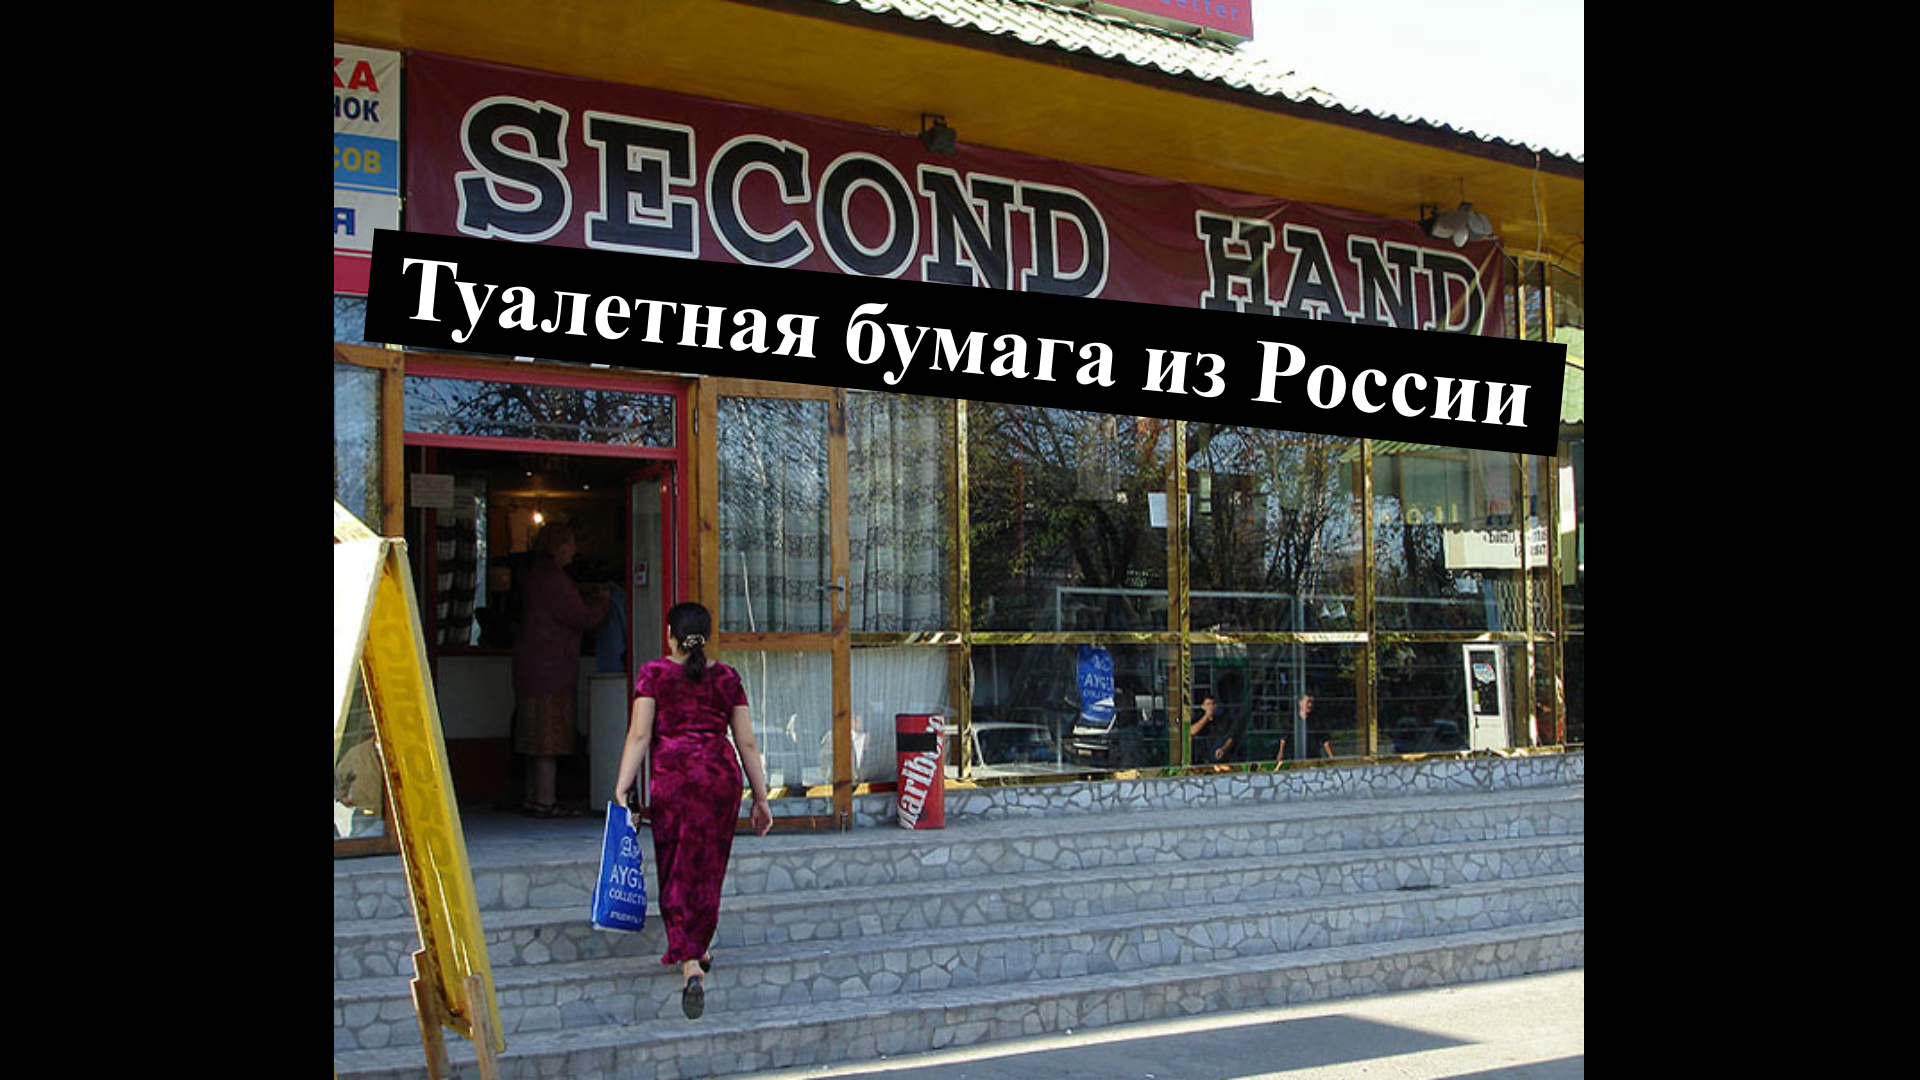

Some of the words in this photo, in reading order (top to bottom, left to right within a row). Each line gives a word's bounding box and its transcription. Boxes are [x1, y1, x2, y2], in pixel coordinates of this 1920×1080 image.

[1163, 0, 1240, 21] etter
[455, 96, 1109, 299] SECOND
[1195, 210, 1485, 335] HAND
[898, 715, 944, 829] arlbo
